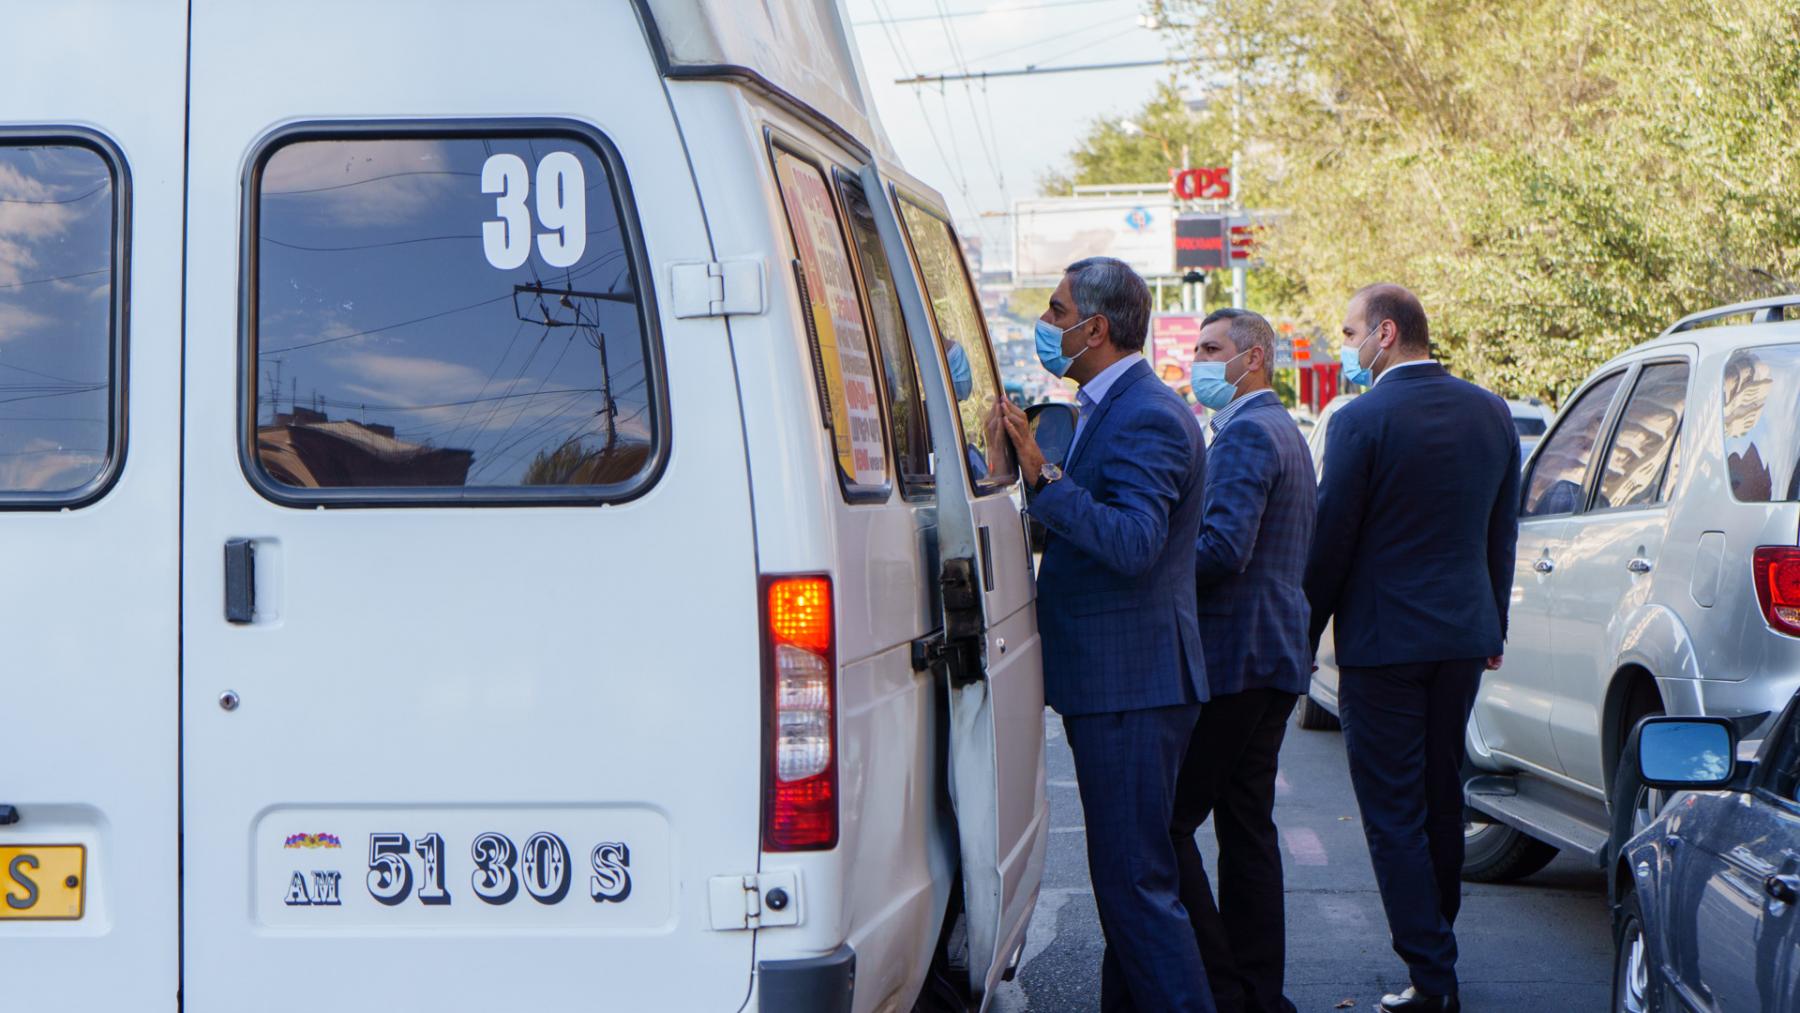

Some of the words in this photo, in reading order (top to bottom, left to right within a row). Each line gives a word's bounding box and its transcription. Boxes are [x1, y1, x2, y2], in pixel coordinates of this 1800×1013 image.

[481, 151, 587, 270] 39
[1175, 167, 1231, 200] CPS
[6, 854, 40, 910] S
[284, 871, 342, 906] AM
[366, 832, 452, 907] 51
[471, 831, 572, 907] 30
[590, 842, 632, 904] S
